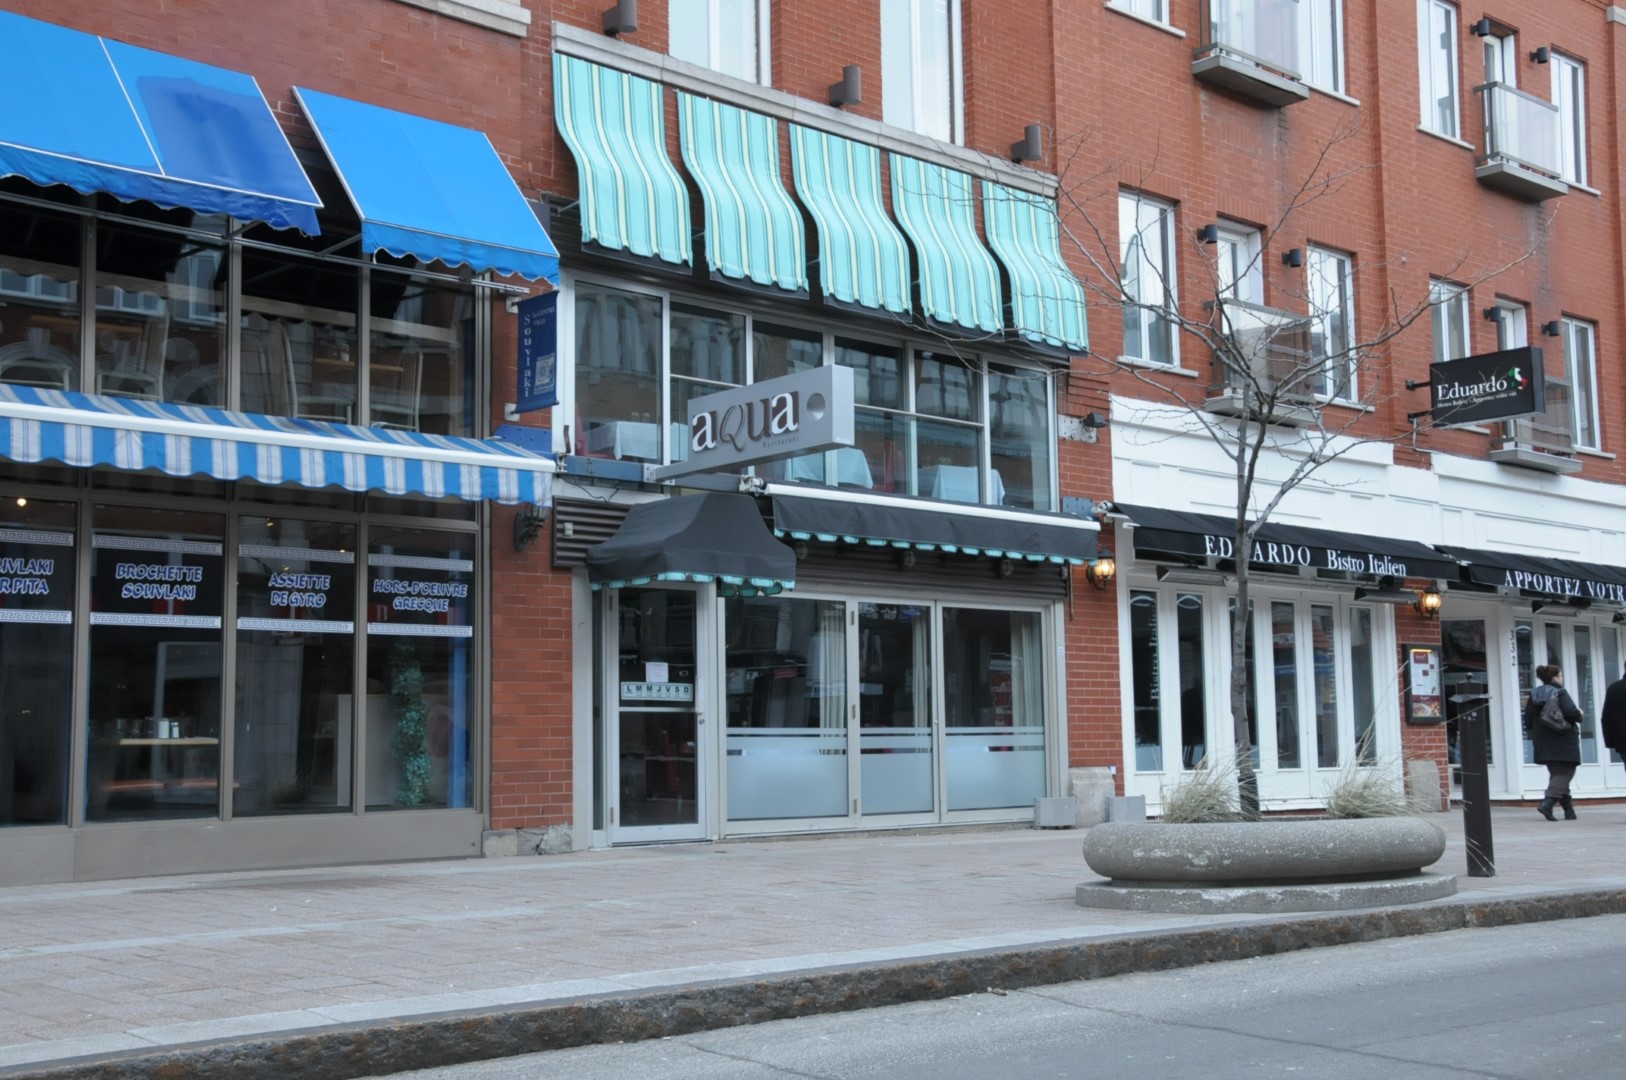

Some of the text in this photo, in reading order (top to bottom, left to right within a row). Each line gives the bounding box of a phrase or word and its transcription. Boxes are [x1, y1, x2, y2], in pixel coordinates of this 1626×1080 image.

[523, 313, 532, 398] Souvlaki
[1437, 375, 1507, 400] Eduardo
[1204, 535, 1407, 577] EDARDO Bistro Italien
[115, 563, 203, 582] BROCHETTE
[268, 572, 331, 590] ASSIETTE
[12, 577, 49, 595] PITA
[121, 582, 196, 600] SOUVLAKI
[1504, 569, 1626, 601] APPORTEZ VOTR
[270, 590, 327, 608] DE GYRO
[393, 596, 449, 613] GRECQUE
